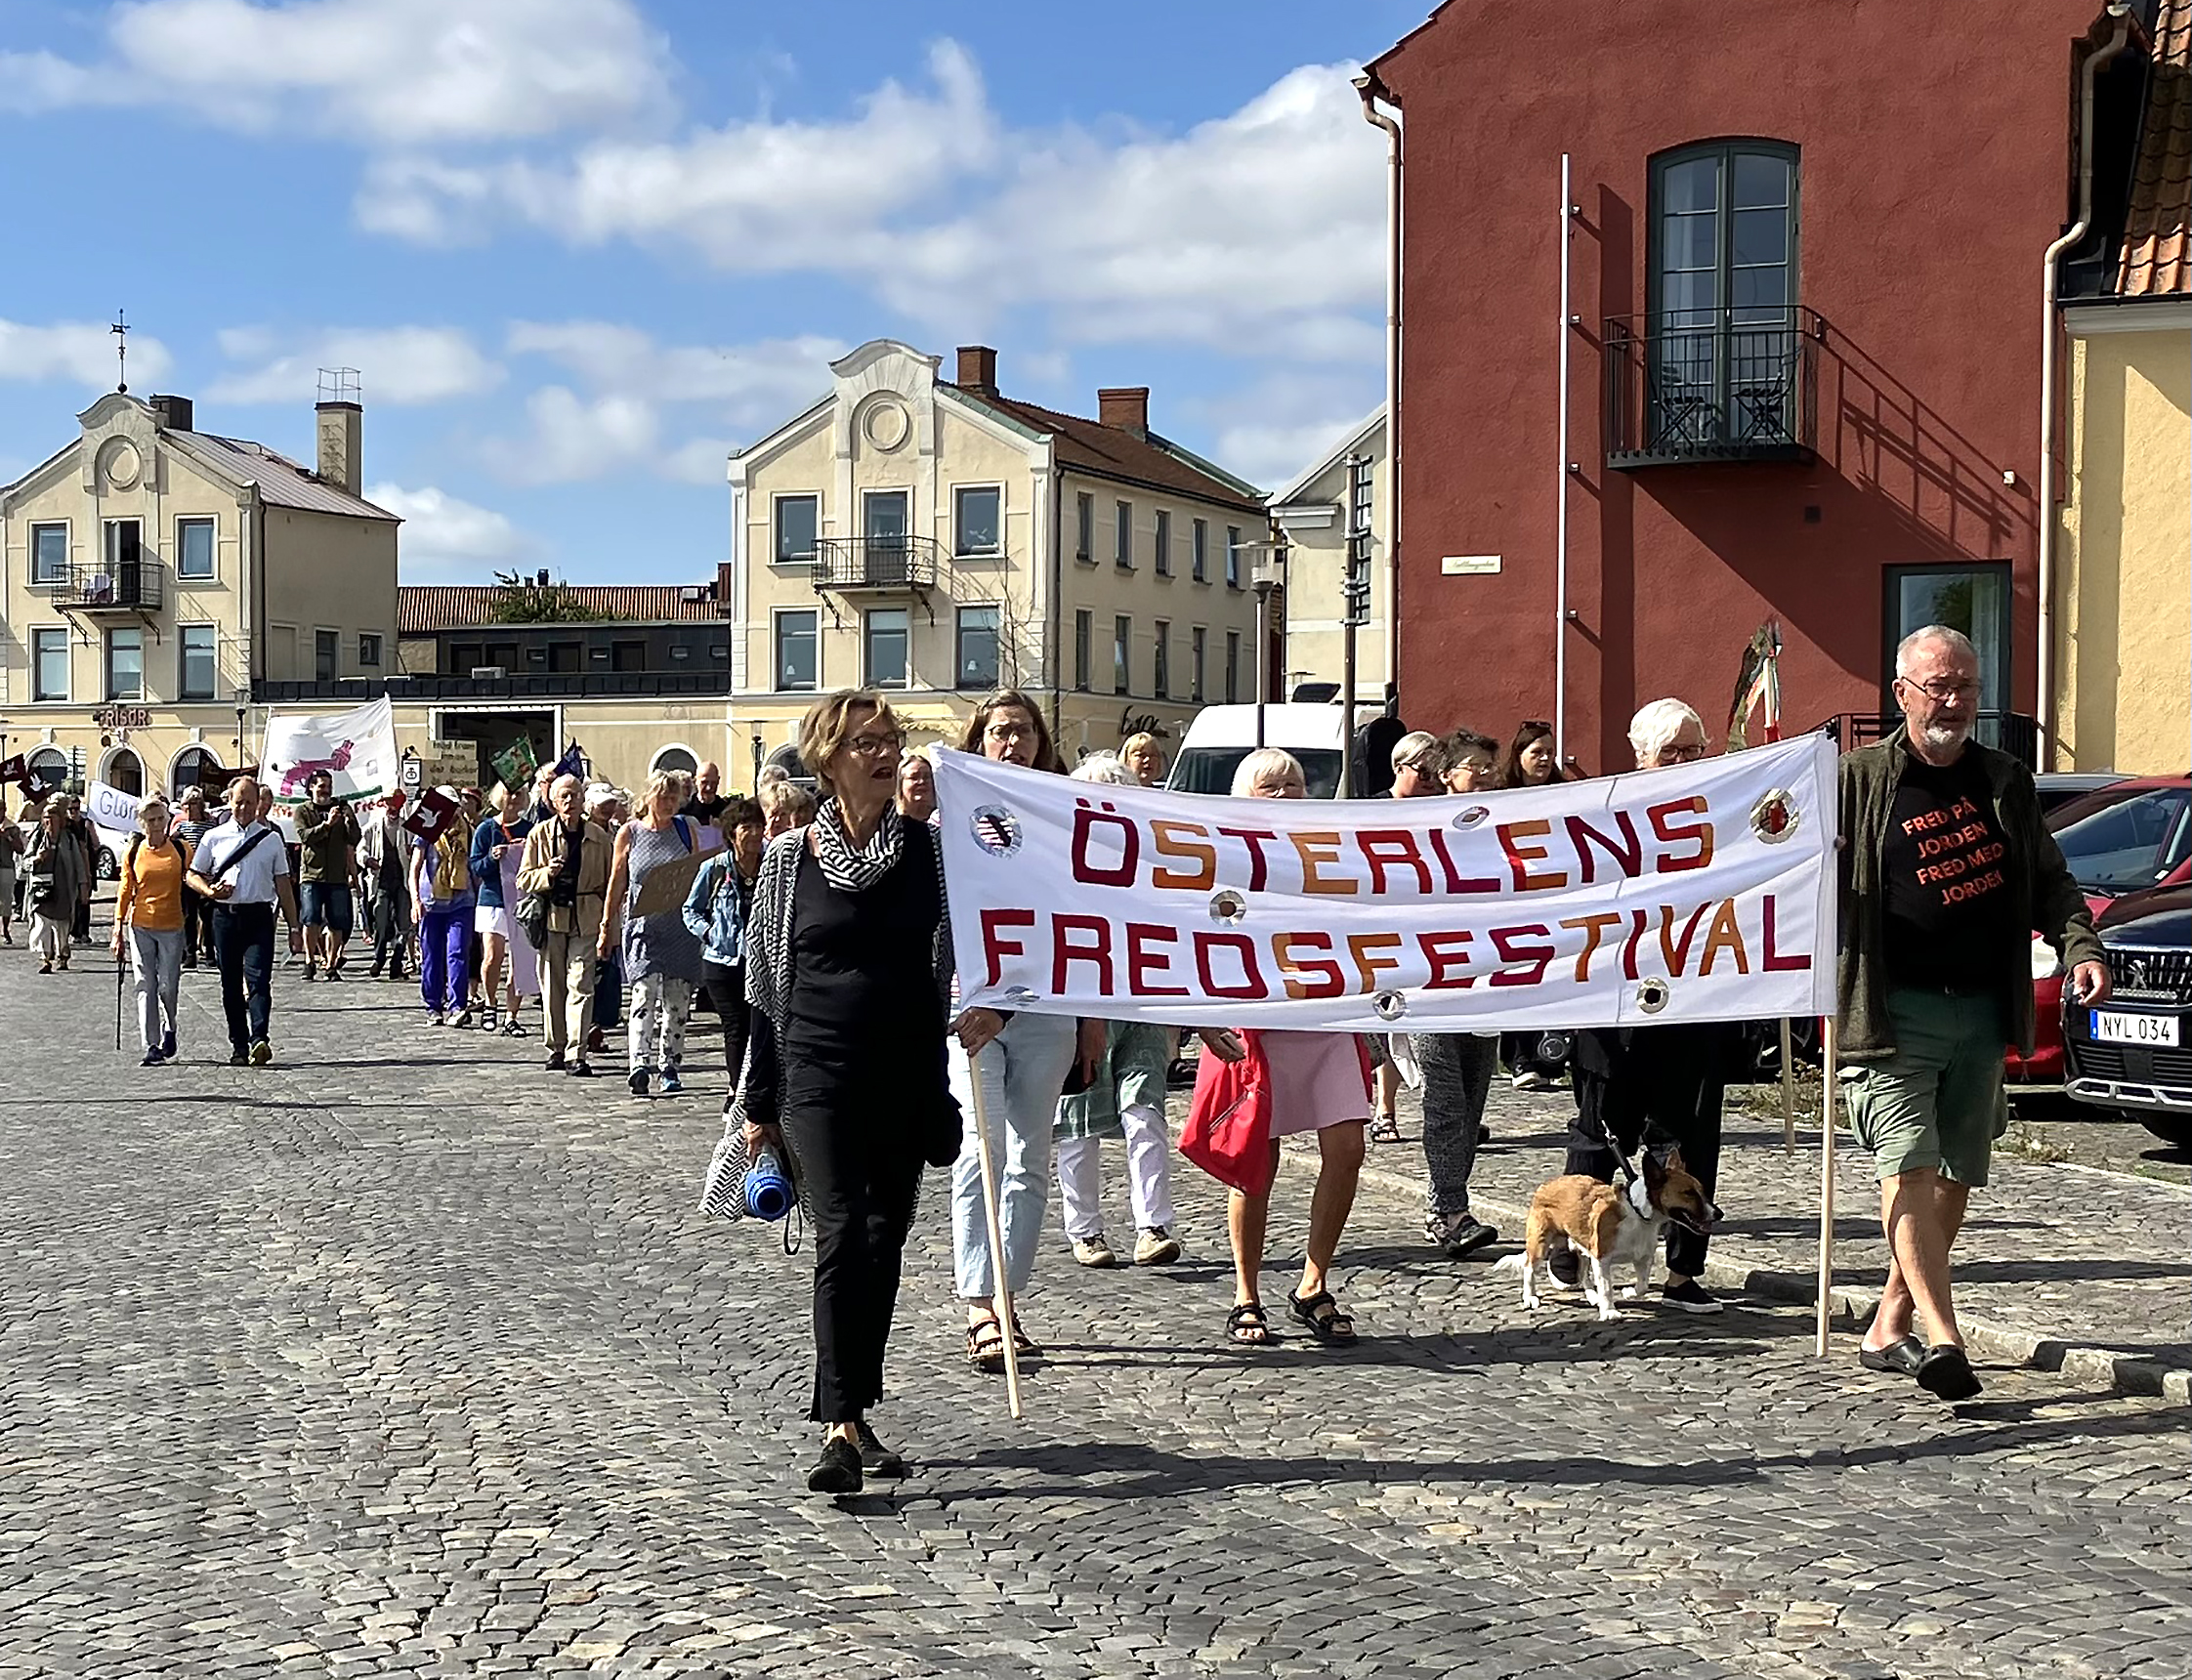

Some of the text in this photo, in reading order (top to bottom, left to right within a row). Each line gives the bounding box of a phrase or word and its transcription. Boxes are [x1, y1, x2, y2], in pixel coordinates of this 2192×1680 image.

[1901, 796, 1978, 836] FRED PÅ
[1072, 795, 1714, 895] ÖSTERLENS
[1918, 821, 1988, 859] JORDEN
[1916, 842, 2003, 885] FRED MED
[979, 894, 1813, 999] FREDSFESTIVAL
[2103, 1016, 2170, 1041] NYL 034
